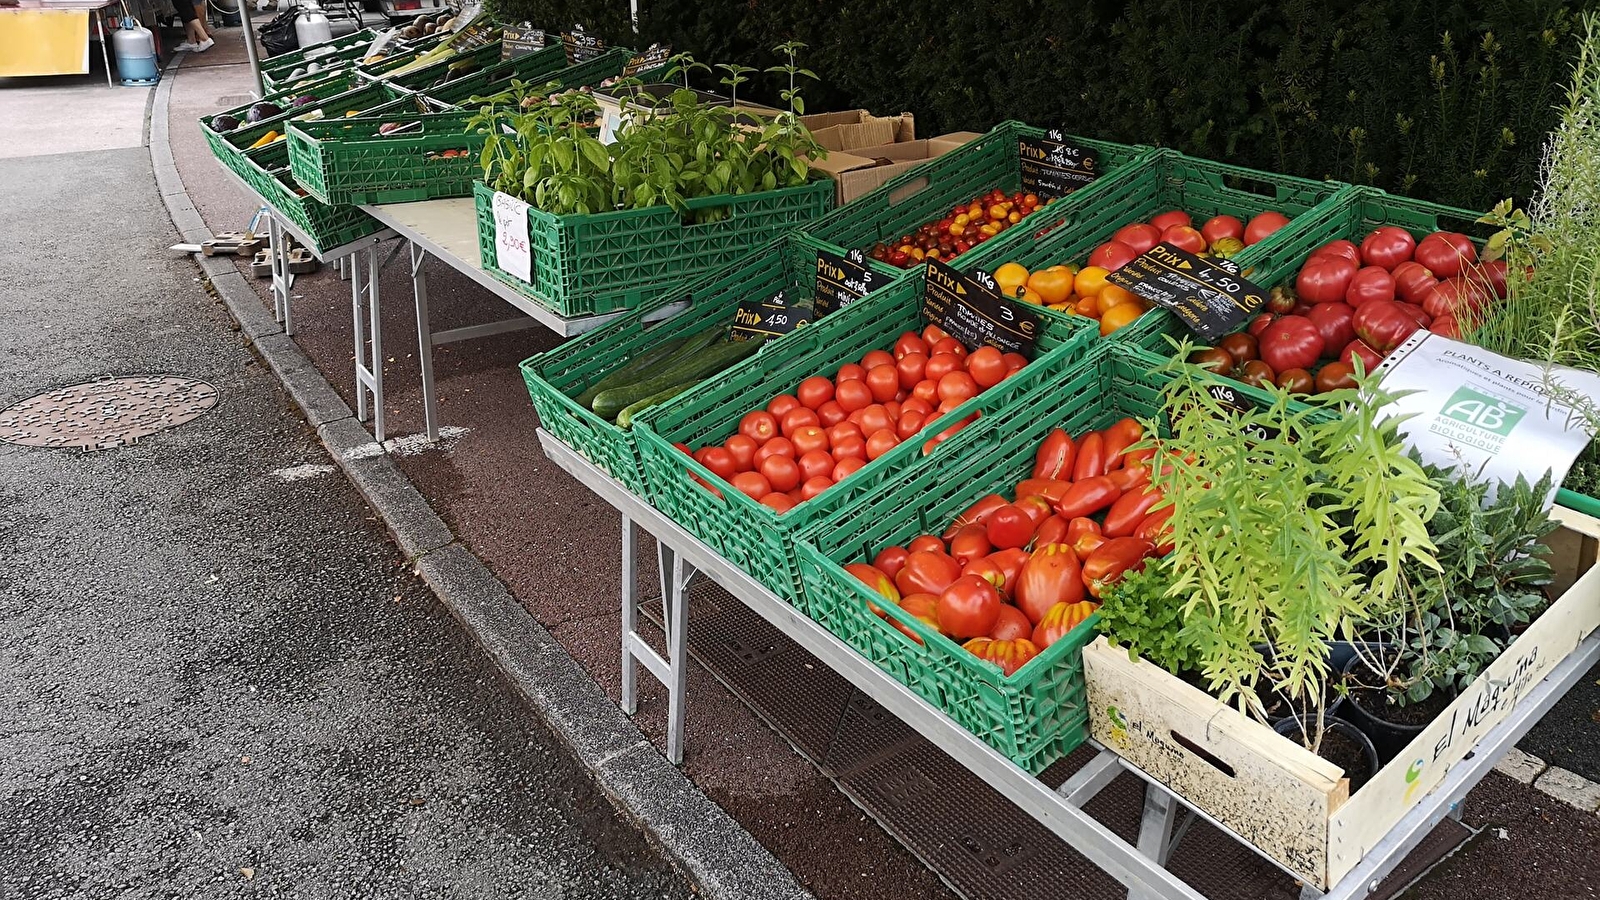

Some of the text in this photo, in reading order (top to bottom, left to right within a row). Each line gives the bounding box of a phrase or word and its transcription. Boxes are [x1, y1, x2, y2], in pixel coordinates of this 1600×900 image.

[1020, 142, 1038, 158] Prix
[1083, 157, 1094, 170] €
[818, 258, 872, 282] Prix 5
[850, 249, 863, 263] 1Kg
[976, 271, 995, 290] 1Kg
[1148, 245, 1181, 266] Prix
[1244, 294, 1263, 308] €
[928, 263, 1035, 334] Prix 3 €
[735, 308, 755, 325] Prix
[1443, 350, 1490, 371] PLANTS
[1436, 358, 1482, 378] Aromatiques
[1492, 381, 1515, 392] plants
[1211, 386, 1234, 401] 1Kg
[1444, 400, 1506, 429] AB
[1430, 423, 1501, 452] BIOLOGIQUE
[1434, 416, 1506, 444] AGRICULTURE
[1432, 709, 1457, 763] El
